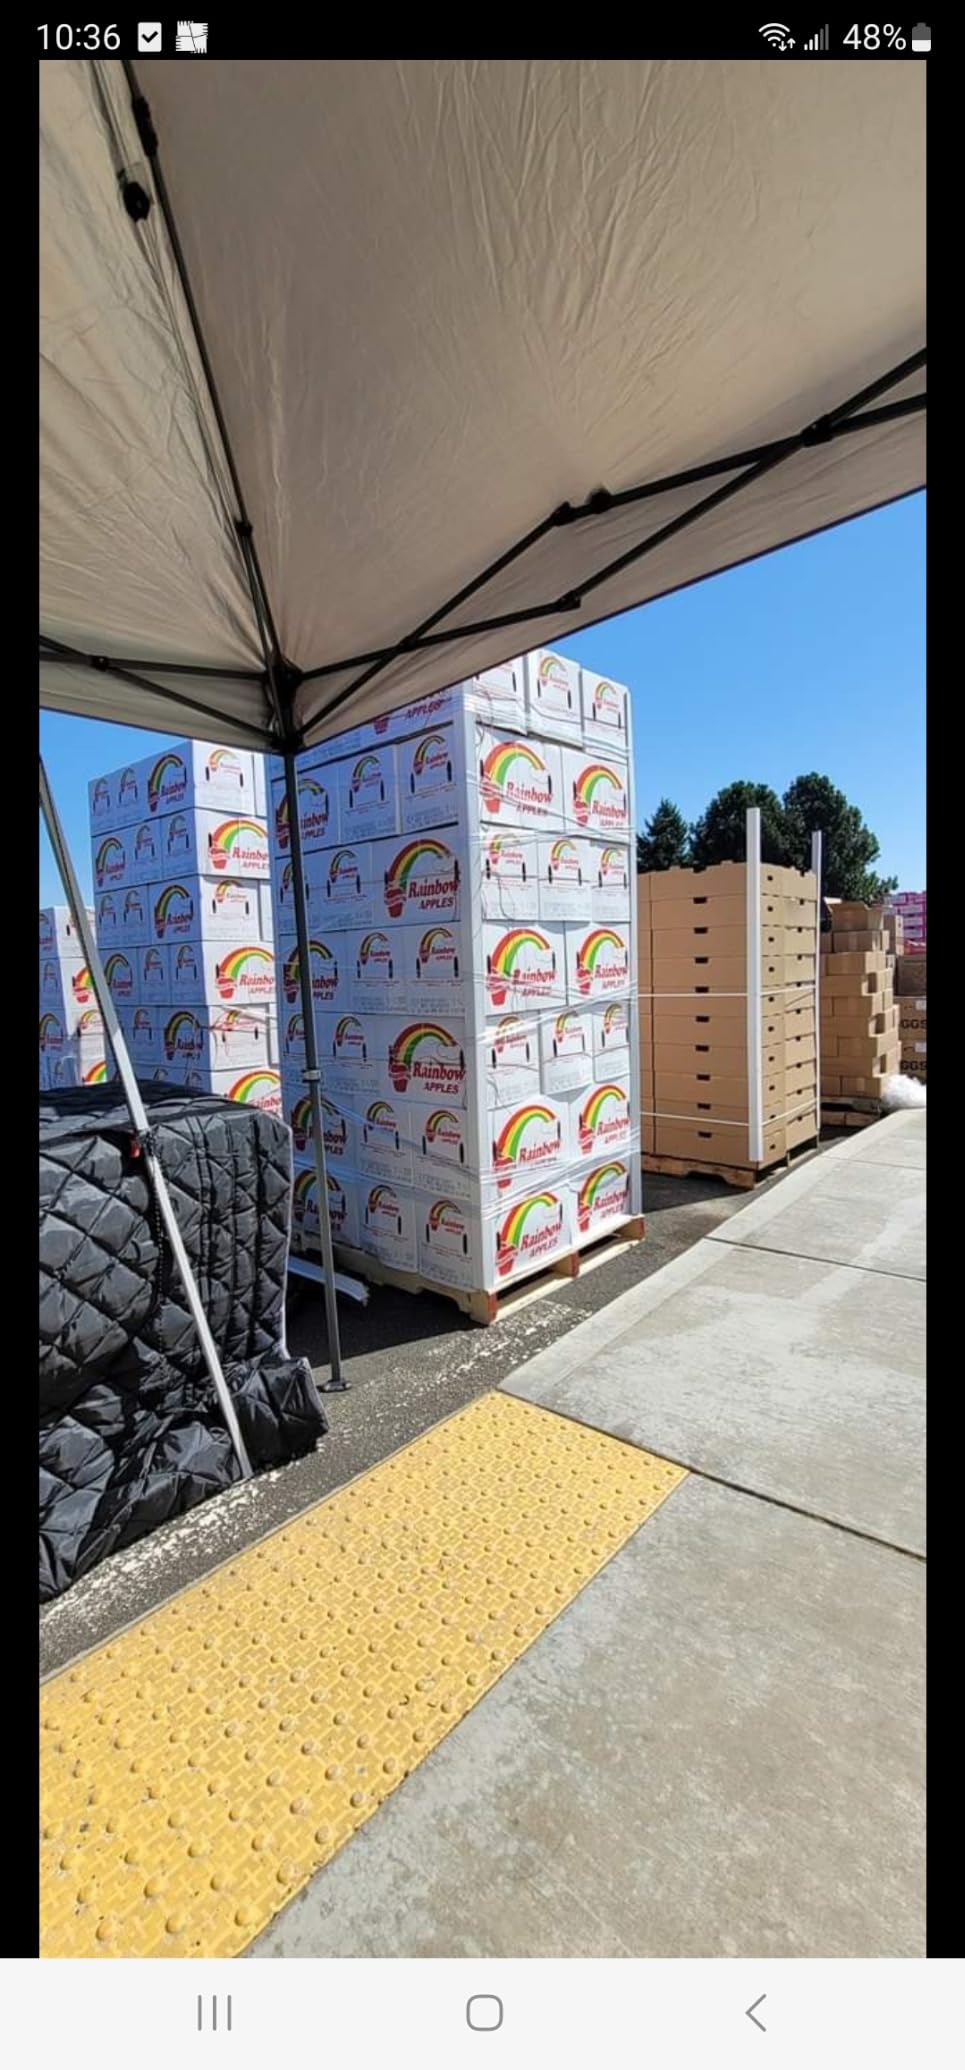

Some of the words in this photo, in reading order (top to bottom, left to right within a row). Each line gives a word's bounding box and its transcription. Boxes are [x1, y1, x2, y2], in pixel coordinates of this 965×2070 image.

[232, 847, 268, 860] Rainbo
[242, 861, 267, 869] APPLE
[408, 880, 461, 898] Rainbow
[418, 898, 454, 910] APPLES
[595, 964, 629, 979] Rainbow
[239, 973, 274, 986] Rainbo
[249, 986, 273, 994] APPLE
[413, 1061, 466, 1080] Rainbow
[423, 1082, 459, 1094] APPLES
[520, 1140, 561, 1162] Rainbow
[593, 1189, 630, 1211] Rainbow
[521, 1222, 562, 1251] Rainbow
[529, 1237, 559, 1257] APPLES
